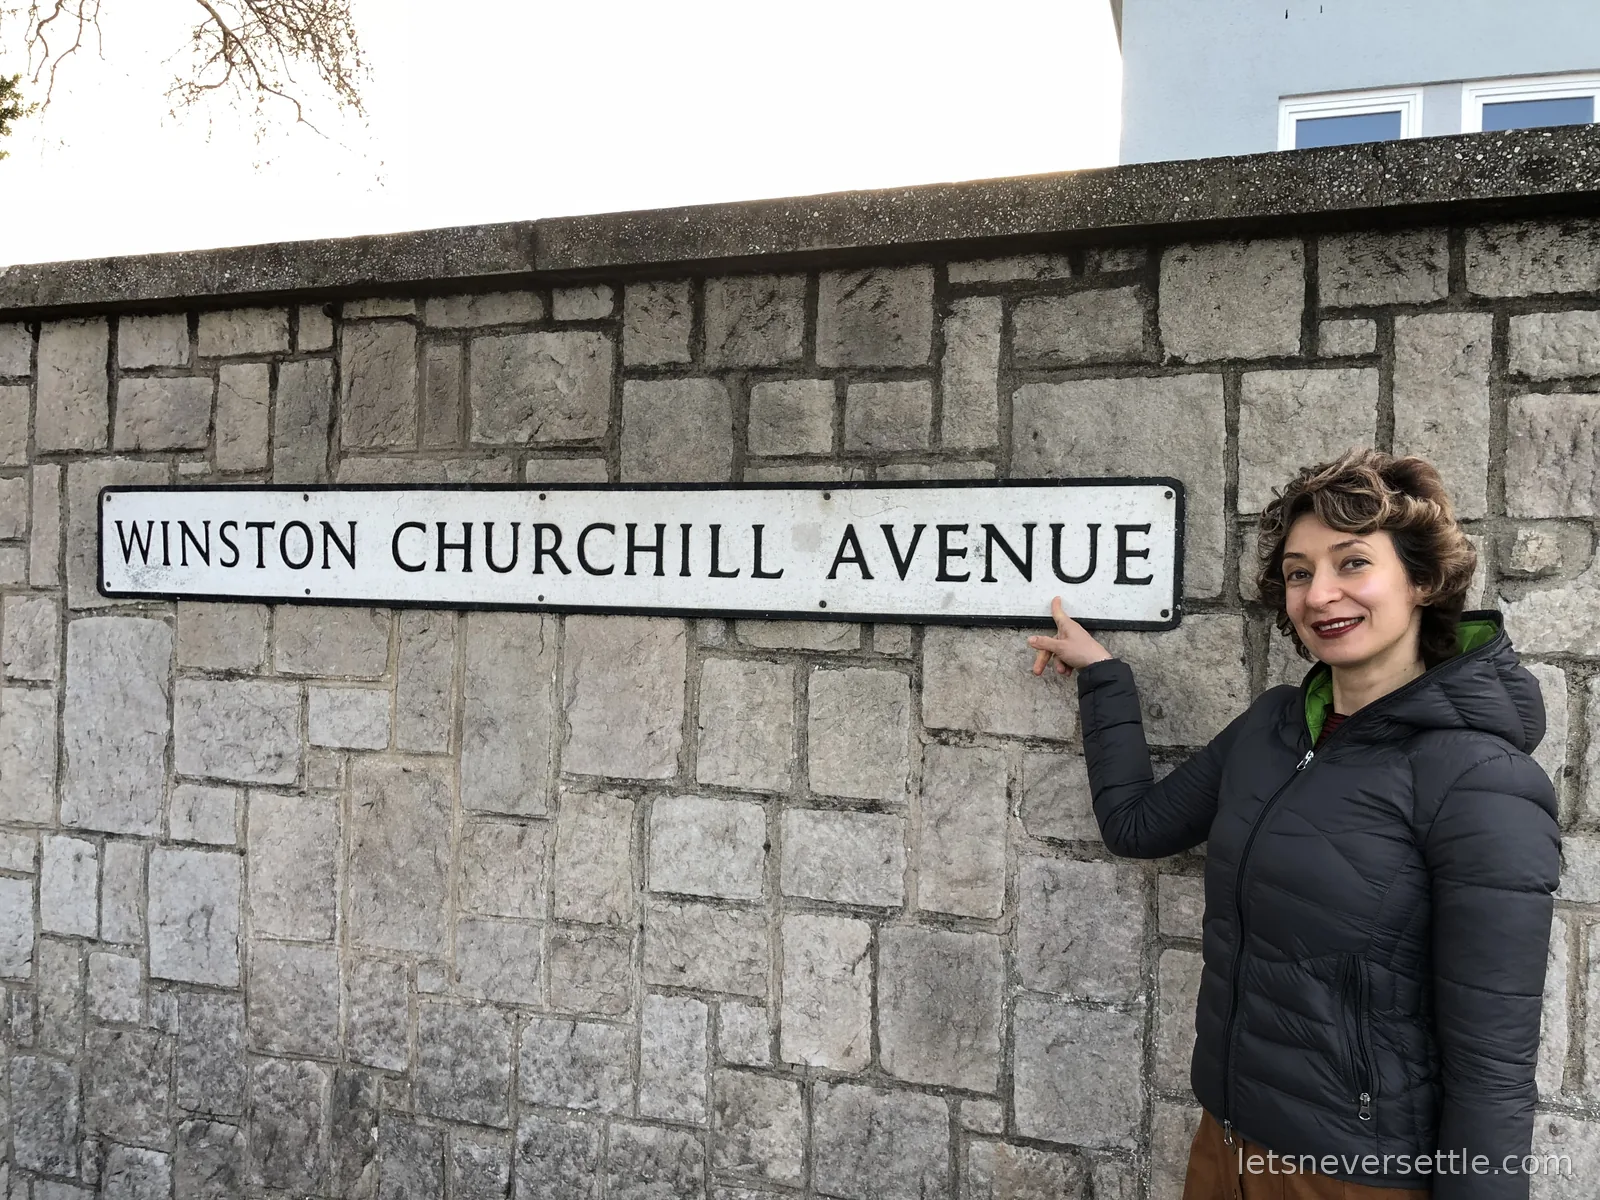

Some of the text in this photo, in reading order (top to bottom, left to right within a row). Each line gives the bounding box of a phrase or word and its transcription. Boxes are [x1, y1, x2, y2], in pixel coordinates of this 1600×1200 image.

[114, 520, 1154, 586] WINSTON CHURCHILL AVENUE
